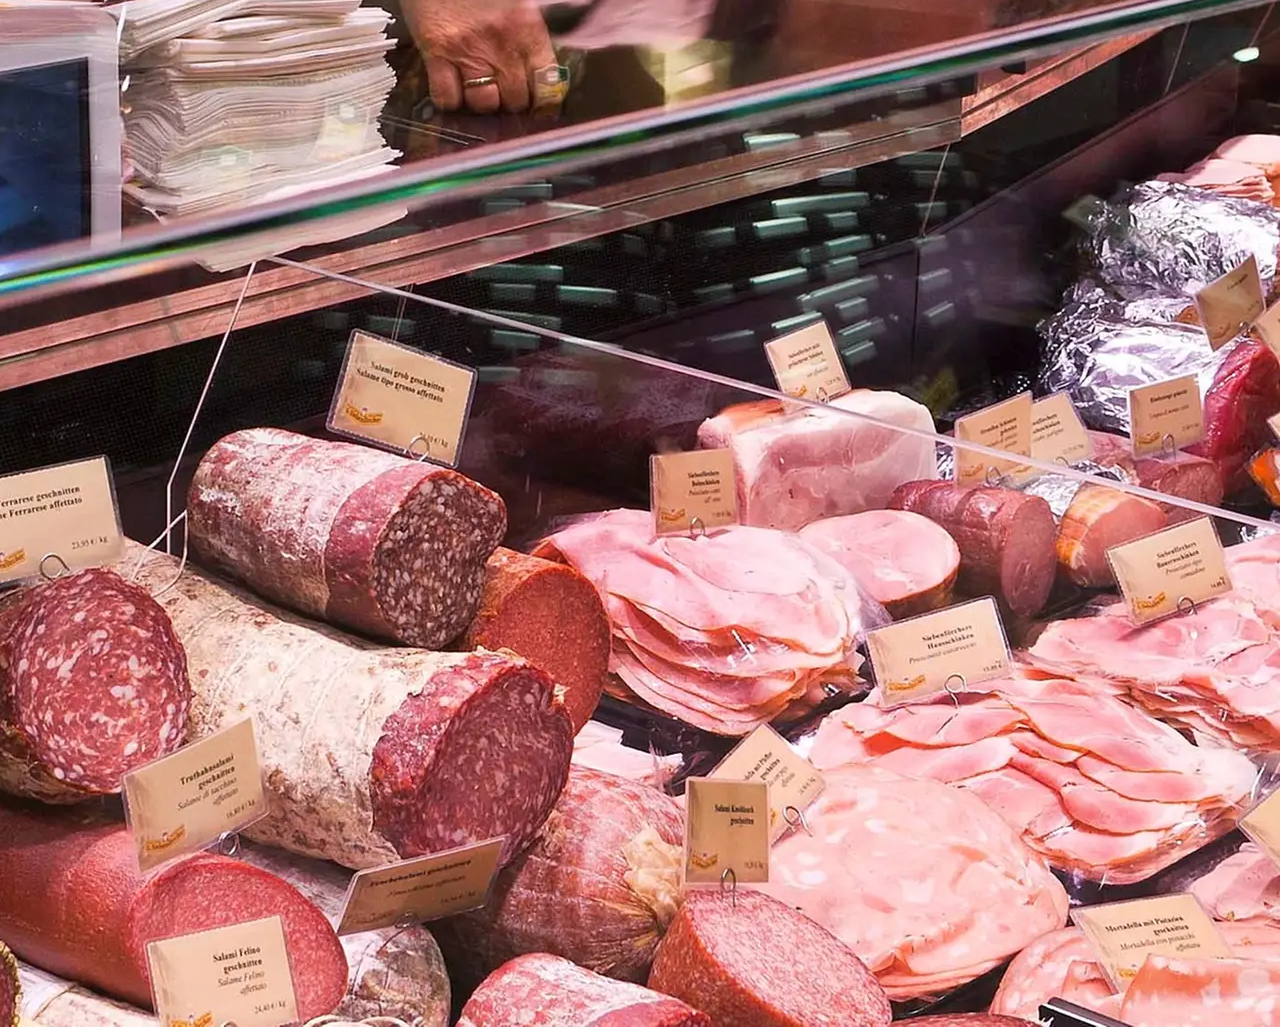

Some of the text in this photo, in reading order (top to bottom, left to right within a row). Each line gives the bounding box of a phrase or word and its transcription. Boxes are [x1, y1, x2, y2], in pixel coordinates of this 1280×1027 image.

[371, 361, 445, 393] Salami grob geschnitten
[357, 368, 443, 403] Salame tipo grosso affettato
[36, 486, 80, 502] geschnitten
[9, 505, 47, 517] Ferrarese
[50, 496, 82, 509] affettato
[927, 634, 974, 650] Hausschinken
[180, 753, 234, 786] Truthahnsalami
[198, 766, 235, 790] geschnitten
[178, 795, 202, 811] Salame
[1105, 922, 1142, 933] Mortadella
[213, 946, 261, 962] Salami Felino
[224, 959, 262, 974] geschnitten
[218, 971, 265, 987] Salame Felino
